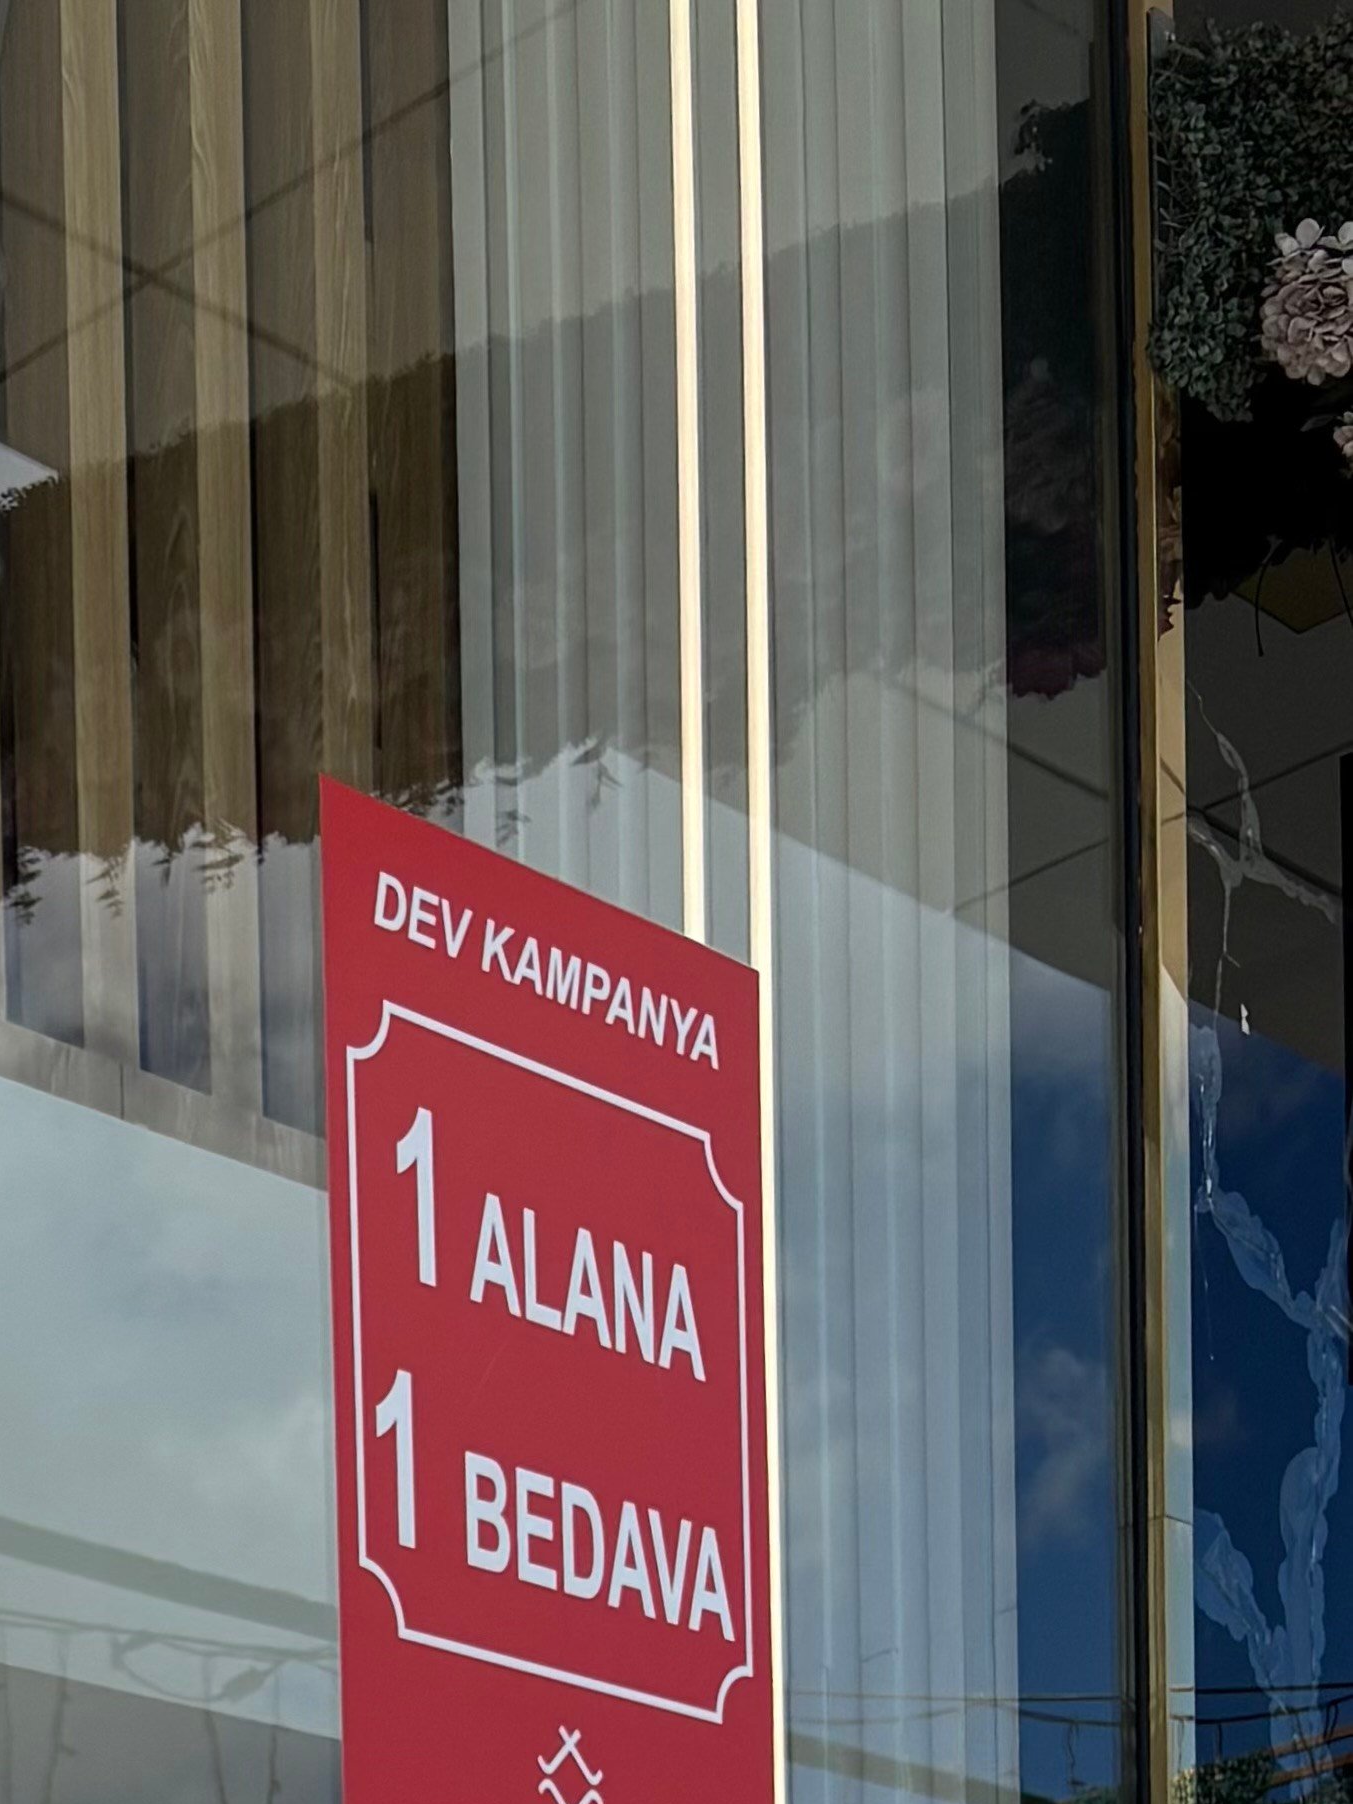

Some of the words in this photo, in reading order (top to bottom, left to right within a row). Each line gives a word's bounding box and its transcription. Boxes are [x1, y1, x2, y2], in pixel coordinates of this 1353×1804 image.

[374, 871, 472, 958] DEV
[481, 918, 720, 1070] KAMPANYA
[396, 1106, 437, 1287] 1
[469, 1192, 706, 1382] ALANA
[375, 1368, 416, 1549] 1
[464, 1450, 736, 1642] BEDAVA
